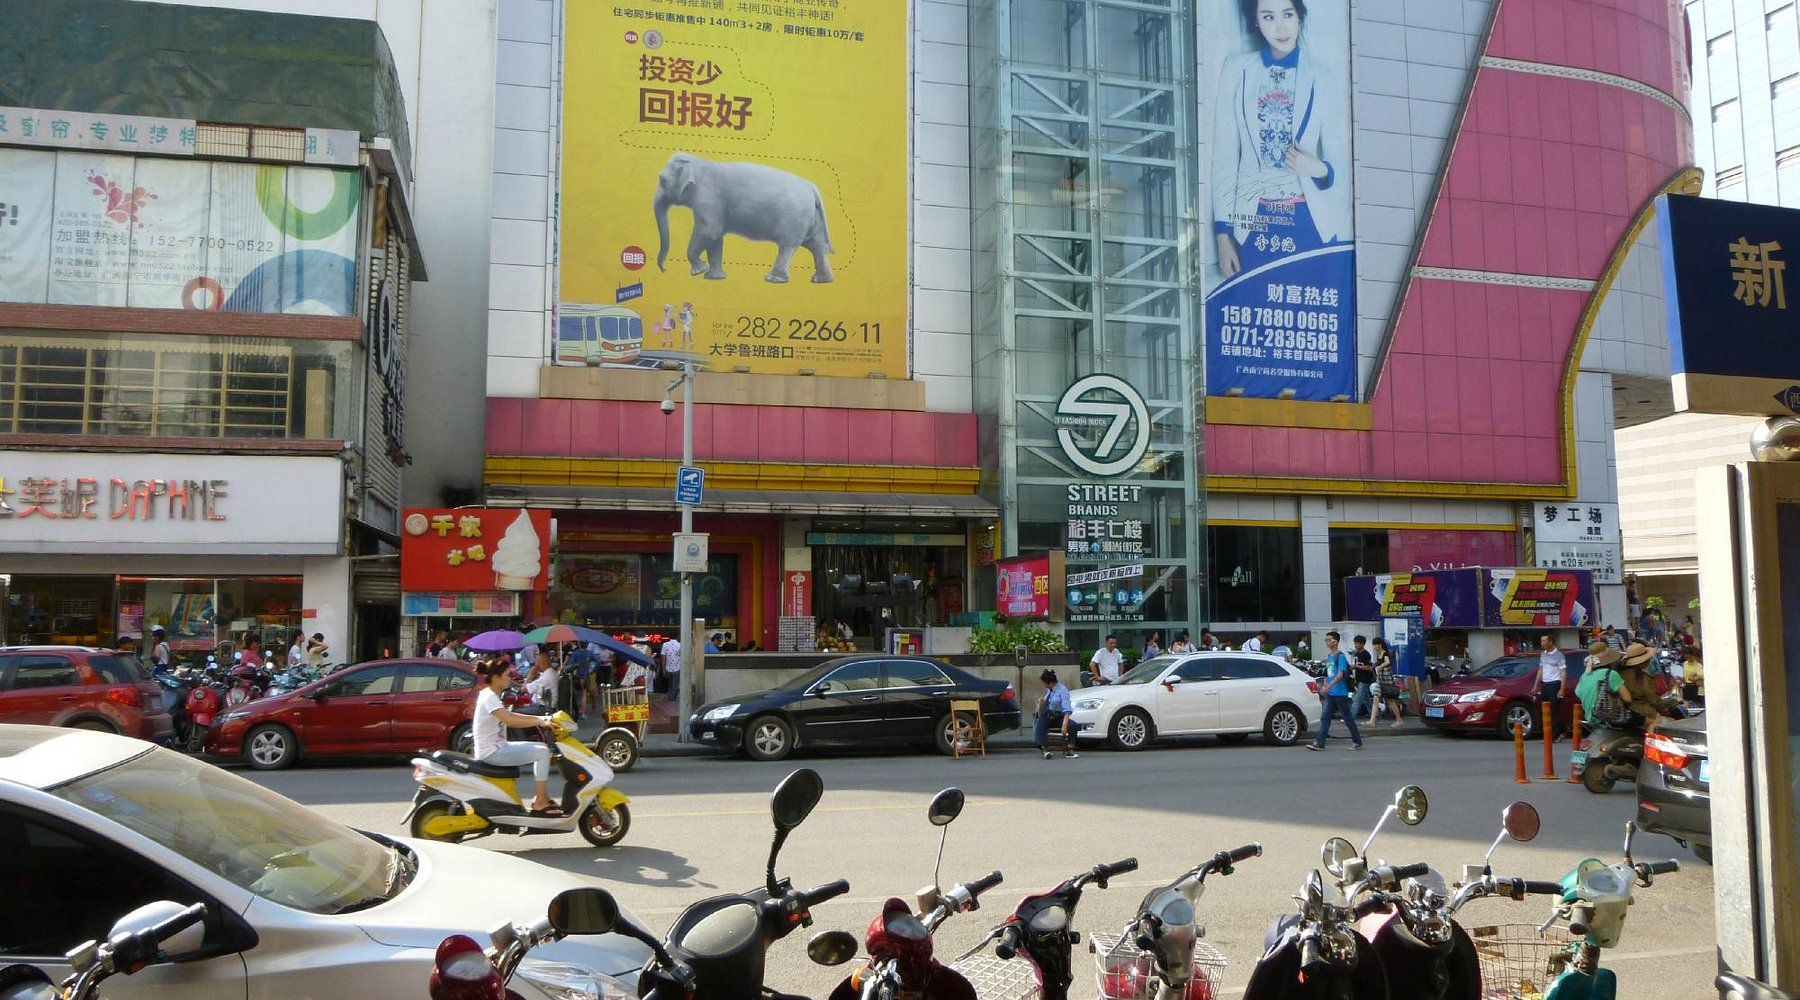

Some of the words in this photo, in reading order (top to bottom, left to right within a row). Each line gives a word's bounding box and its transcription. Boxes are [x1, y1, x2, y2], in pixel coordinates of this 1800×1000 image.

[639, 54, 722, 86] 投资少
[639, 88, 753, 130] 回报好
[150, 235, 273, 252] 152-7700-0522
[623, 252, 645, 265] 回报
[1729, 237, 1786, 309] 新
[1267, 284, 1338, 307] 财富热线
[737, 316, 781, 339] 282
[788, 319, 847, 342] 2266
[1221, 305, 1251, 325] 158
[1254, 308, 1294, 328] 7880
[1297, 311, 1338, 332] 0665
[1221, 325, 1338, 351] 0771-2836588
[709, 343, 794, 359] 大学鲁班路口
[109, 477, 228, 520] DAPHNE
[1067, 484, 1141, 502] STREET
[1068, 504, 1118, 516] BRANDS
[1544, 506, 1602, 524] 梦工场
[1067, 519, 1142, 539] 裕丰七楼
[1067, 540, 1089, 553] 男装
